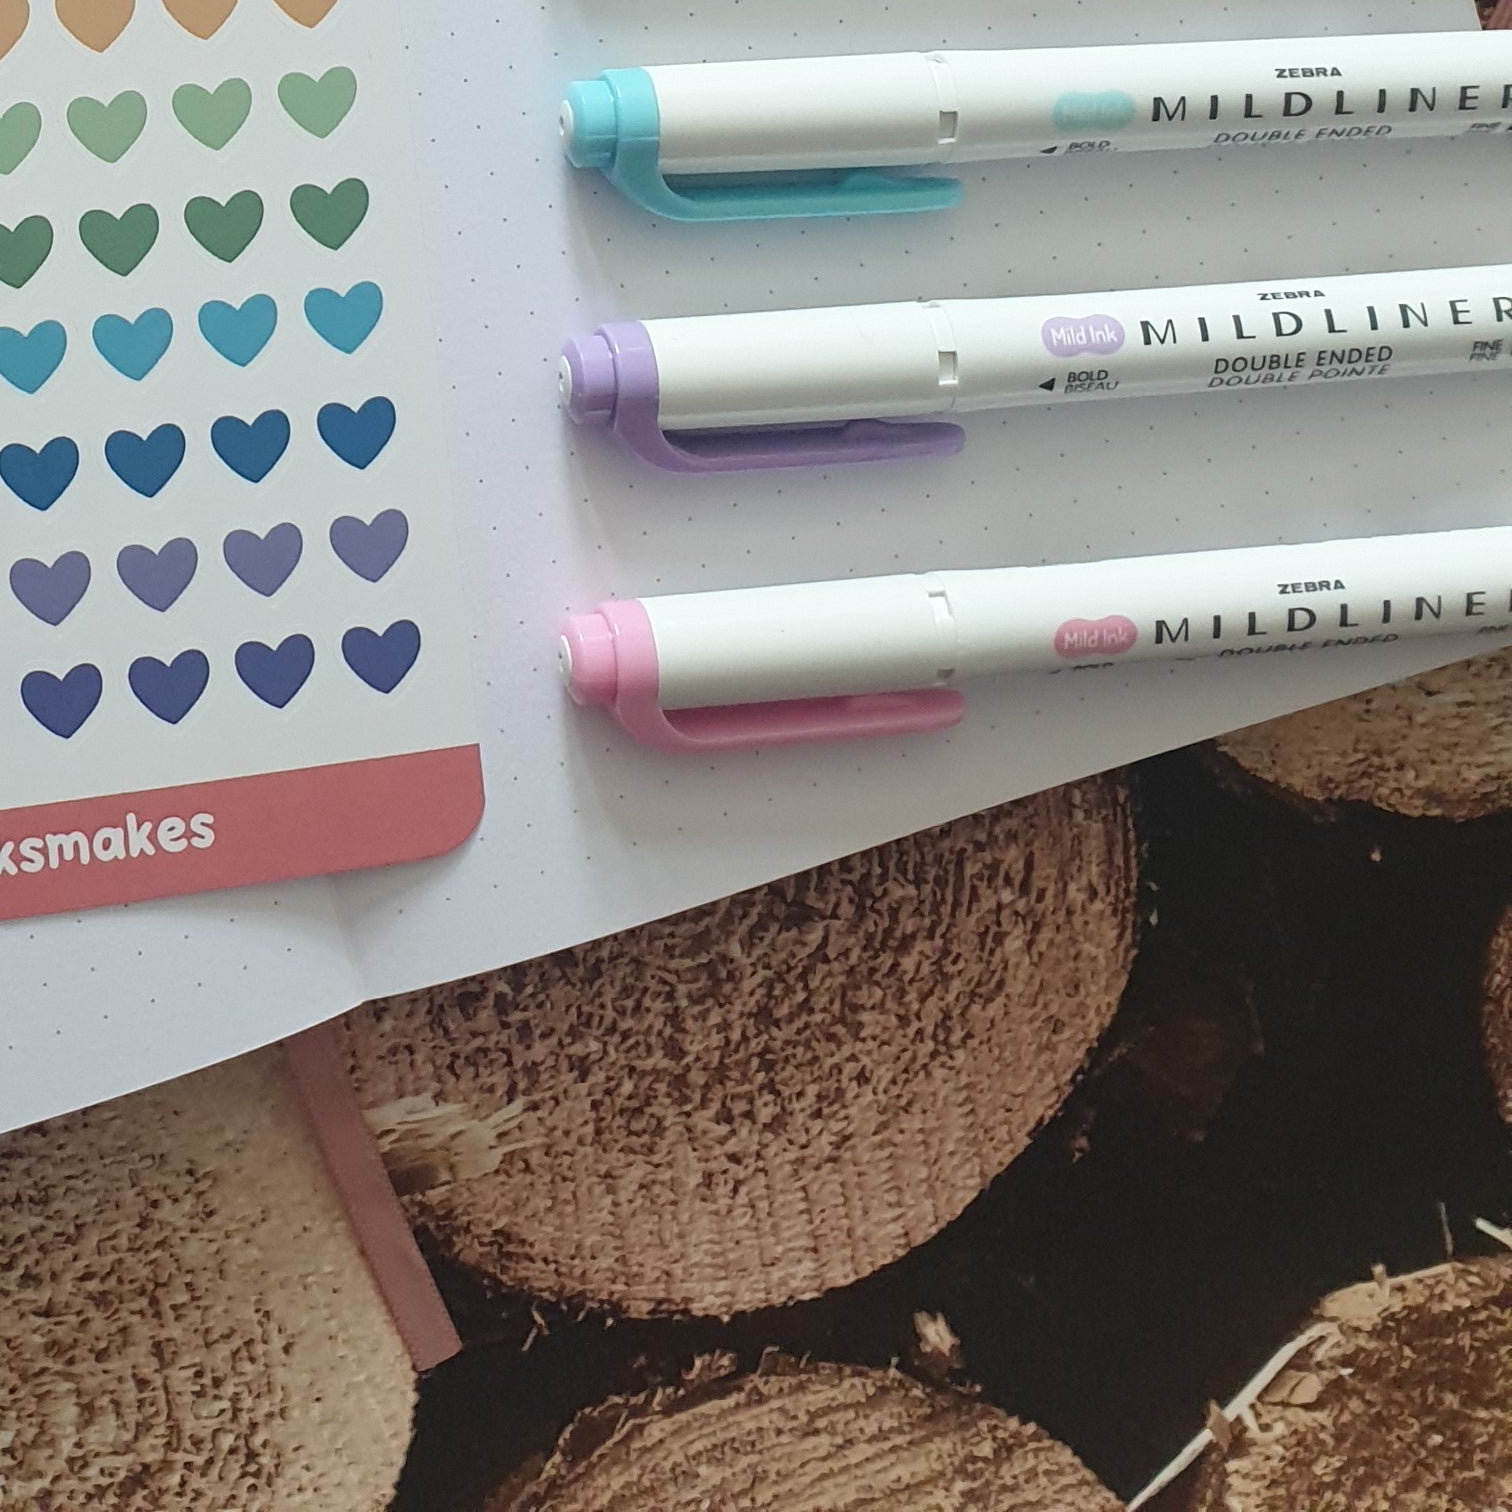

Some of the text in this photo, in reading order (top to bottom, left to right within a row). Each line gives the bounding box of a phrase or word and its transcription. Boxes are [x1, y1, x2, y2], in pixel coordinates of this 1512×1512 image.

[1274, 67, 1342, 79] ZEBRA
[1213, 125, 1393, 144] DOUBLE ENDED
[1067, 140, 1111, 151] BOLD
[1256, 290, 1326, 301] ZEBRA
[1139, 296, 1512, 346] MILDLINER
[1050, 325, 1119, 347] Mild Ink
[1472, 339, 1504, 354] FINE
[1213, 345, 1393, 375] DOUBLE ENDED
[1066, 369, 1109, 383] BOLD
[1208, 364, 1392, 389] DOUBLE POINTE
[1064, 380, 1120, 394] BISEAU
[1277, 579, 1346, 595] ZEBRA
[1154, 589, 1512, 645] MILDLINE
[1063, 626, 1129, 650] Mild Ink
